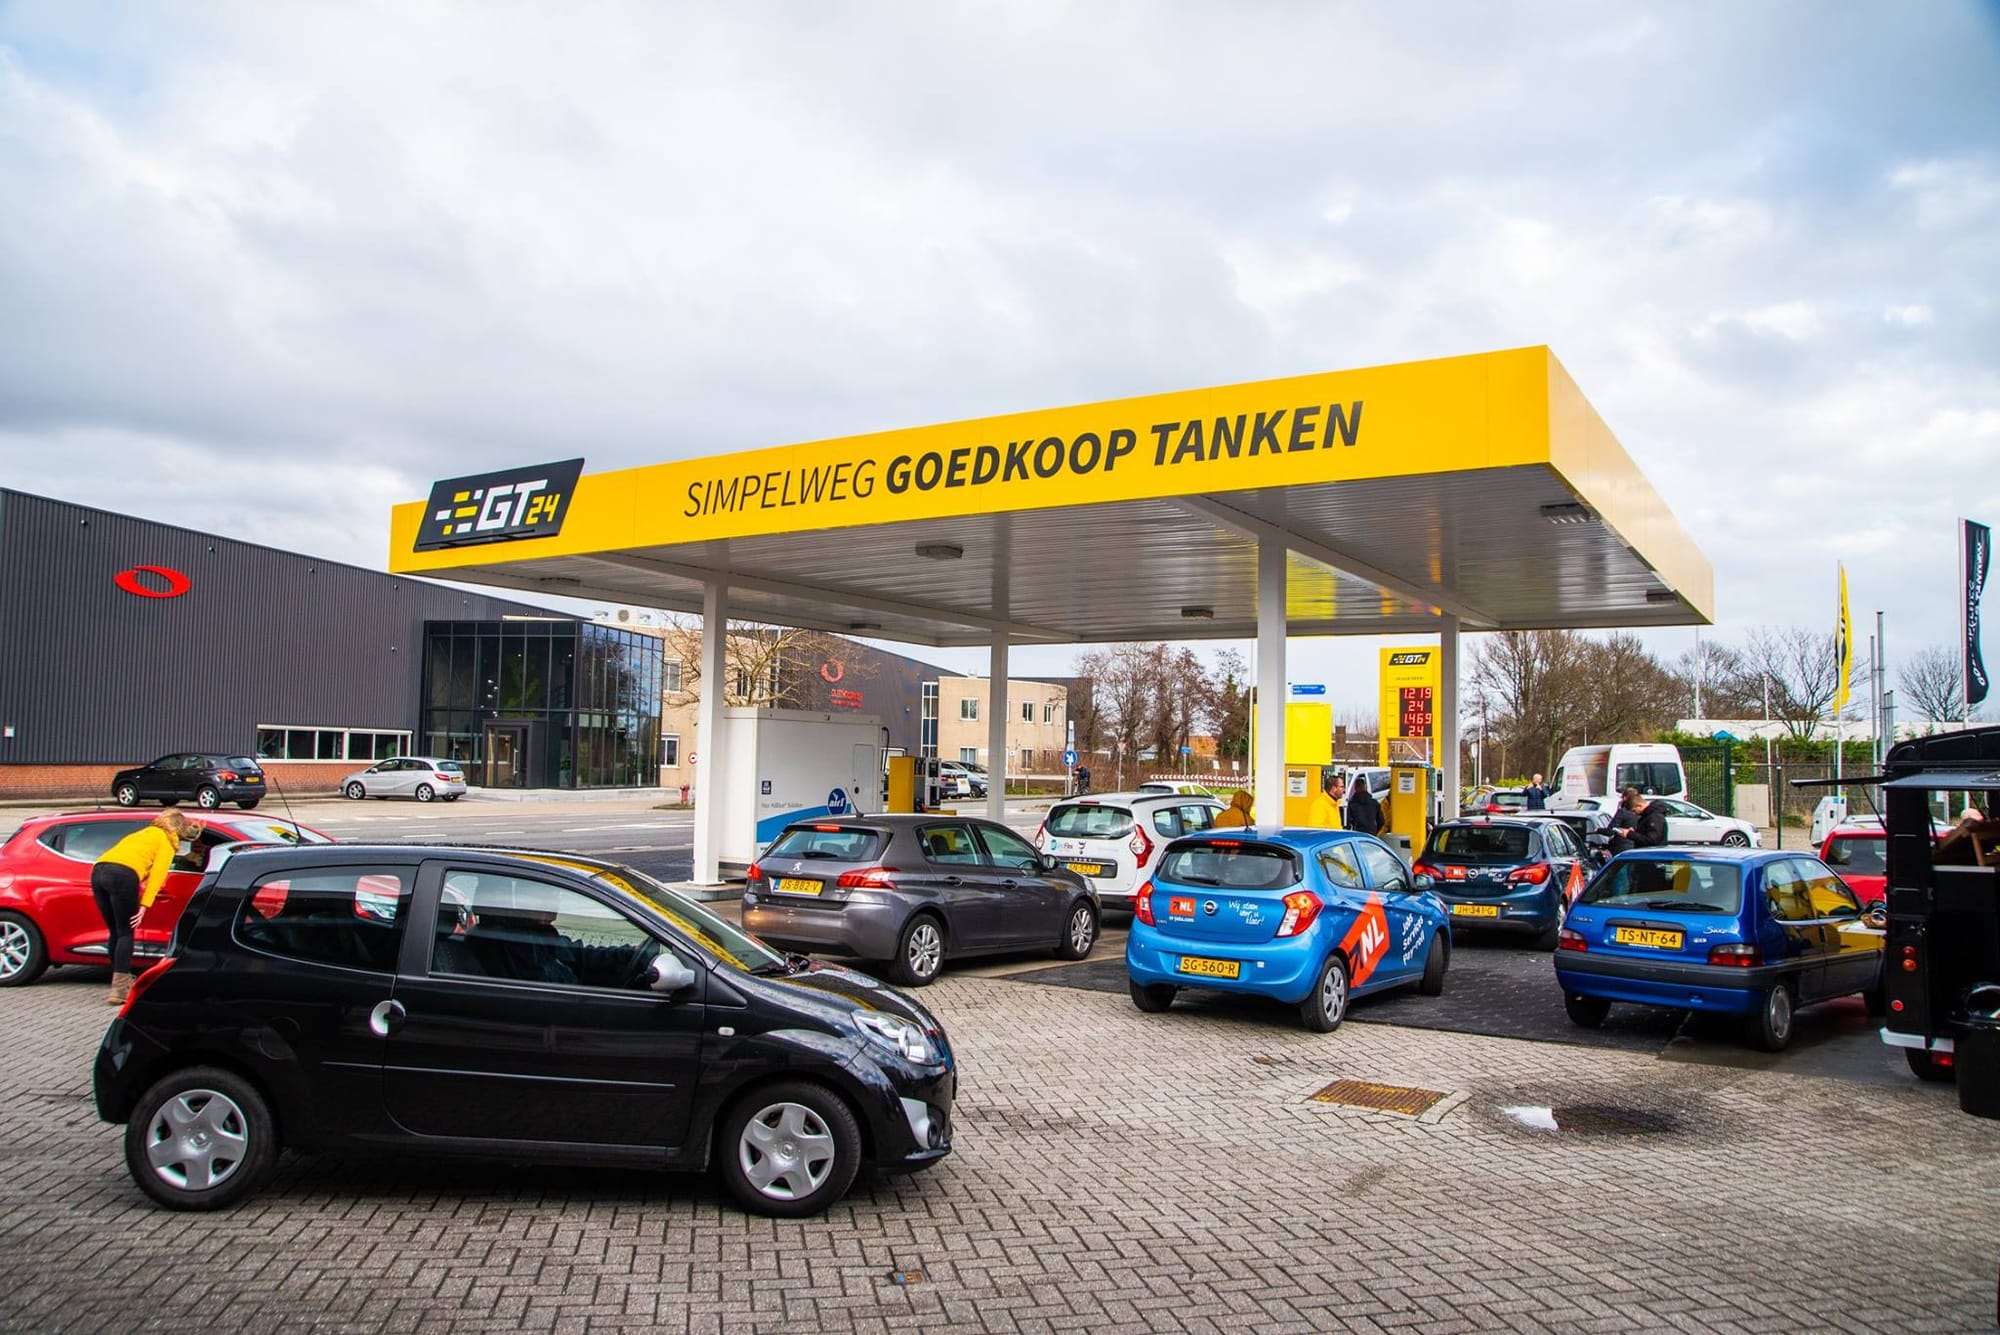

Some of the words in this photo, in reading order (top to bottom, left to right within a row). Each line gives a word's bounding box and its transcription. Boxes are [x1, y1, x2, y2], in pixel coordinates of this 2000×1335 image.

[683, 459, 876, 518] SIMPELWEG
[885, 428, 1137, 494] GOEDKOOP
[1150, 400, 1364, 467] TANKEN
[1408, 700, 1424, 712] 24
[1408, 725, 1424, 737] 24
[1179, 901, 1193, 912] NL
[1228, 899, 1241, 912] Wij
[1457, 906, 1494, 916] JH-341-G
[1402, 912, 1414, 936] Jobs
[1361, 915, 1385, 964] NL
[1620, 929, 1677, 946] TS-NT-64
[1183, 958, 1236, 975] SG-560-R
